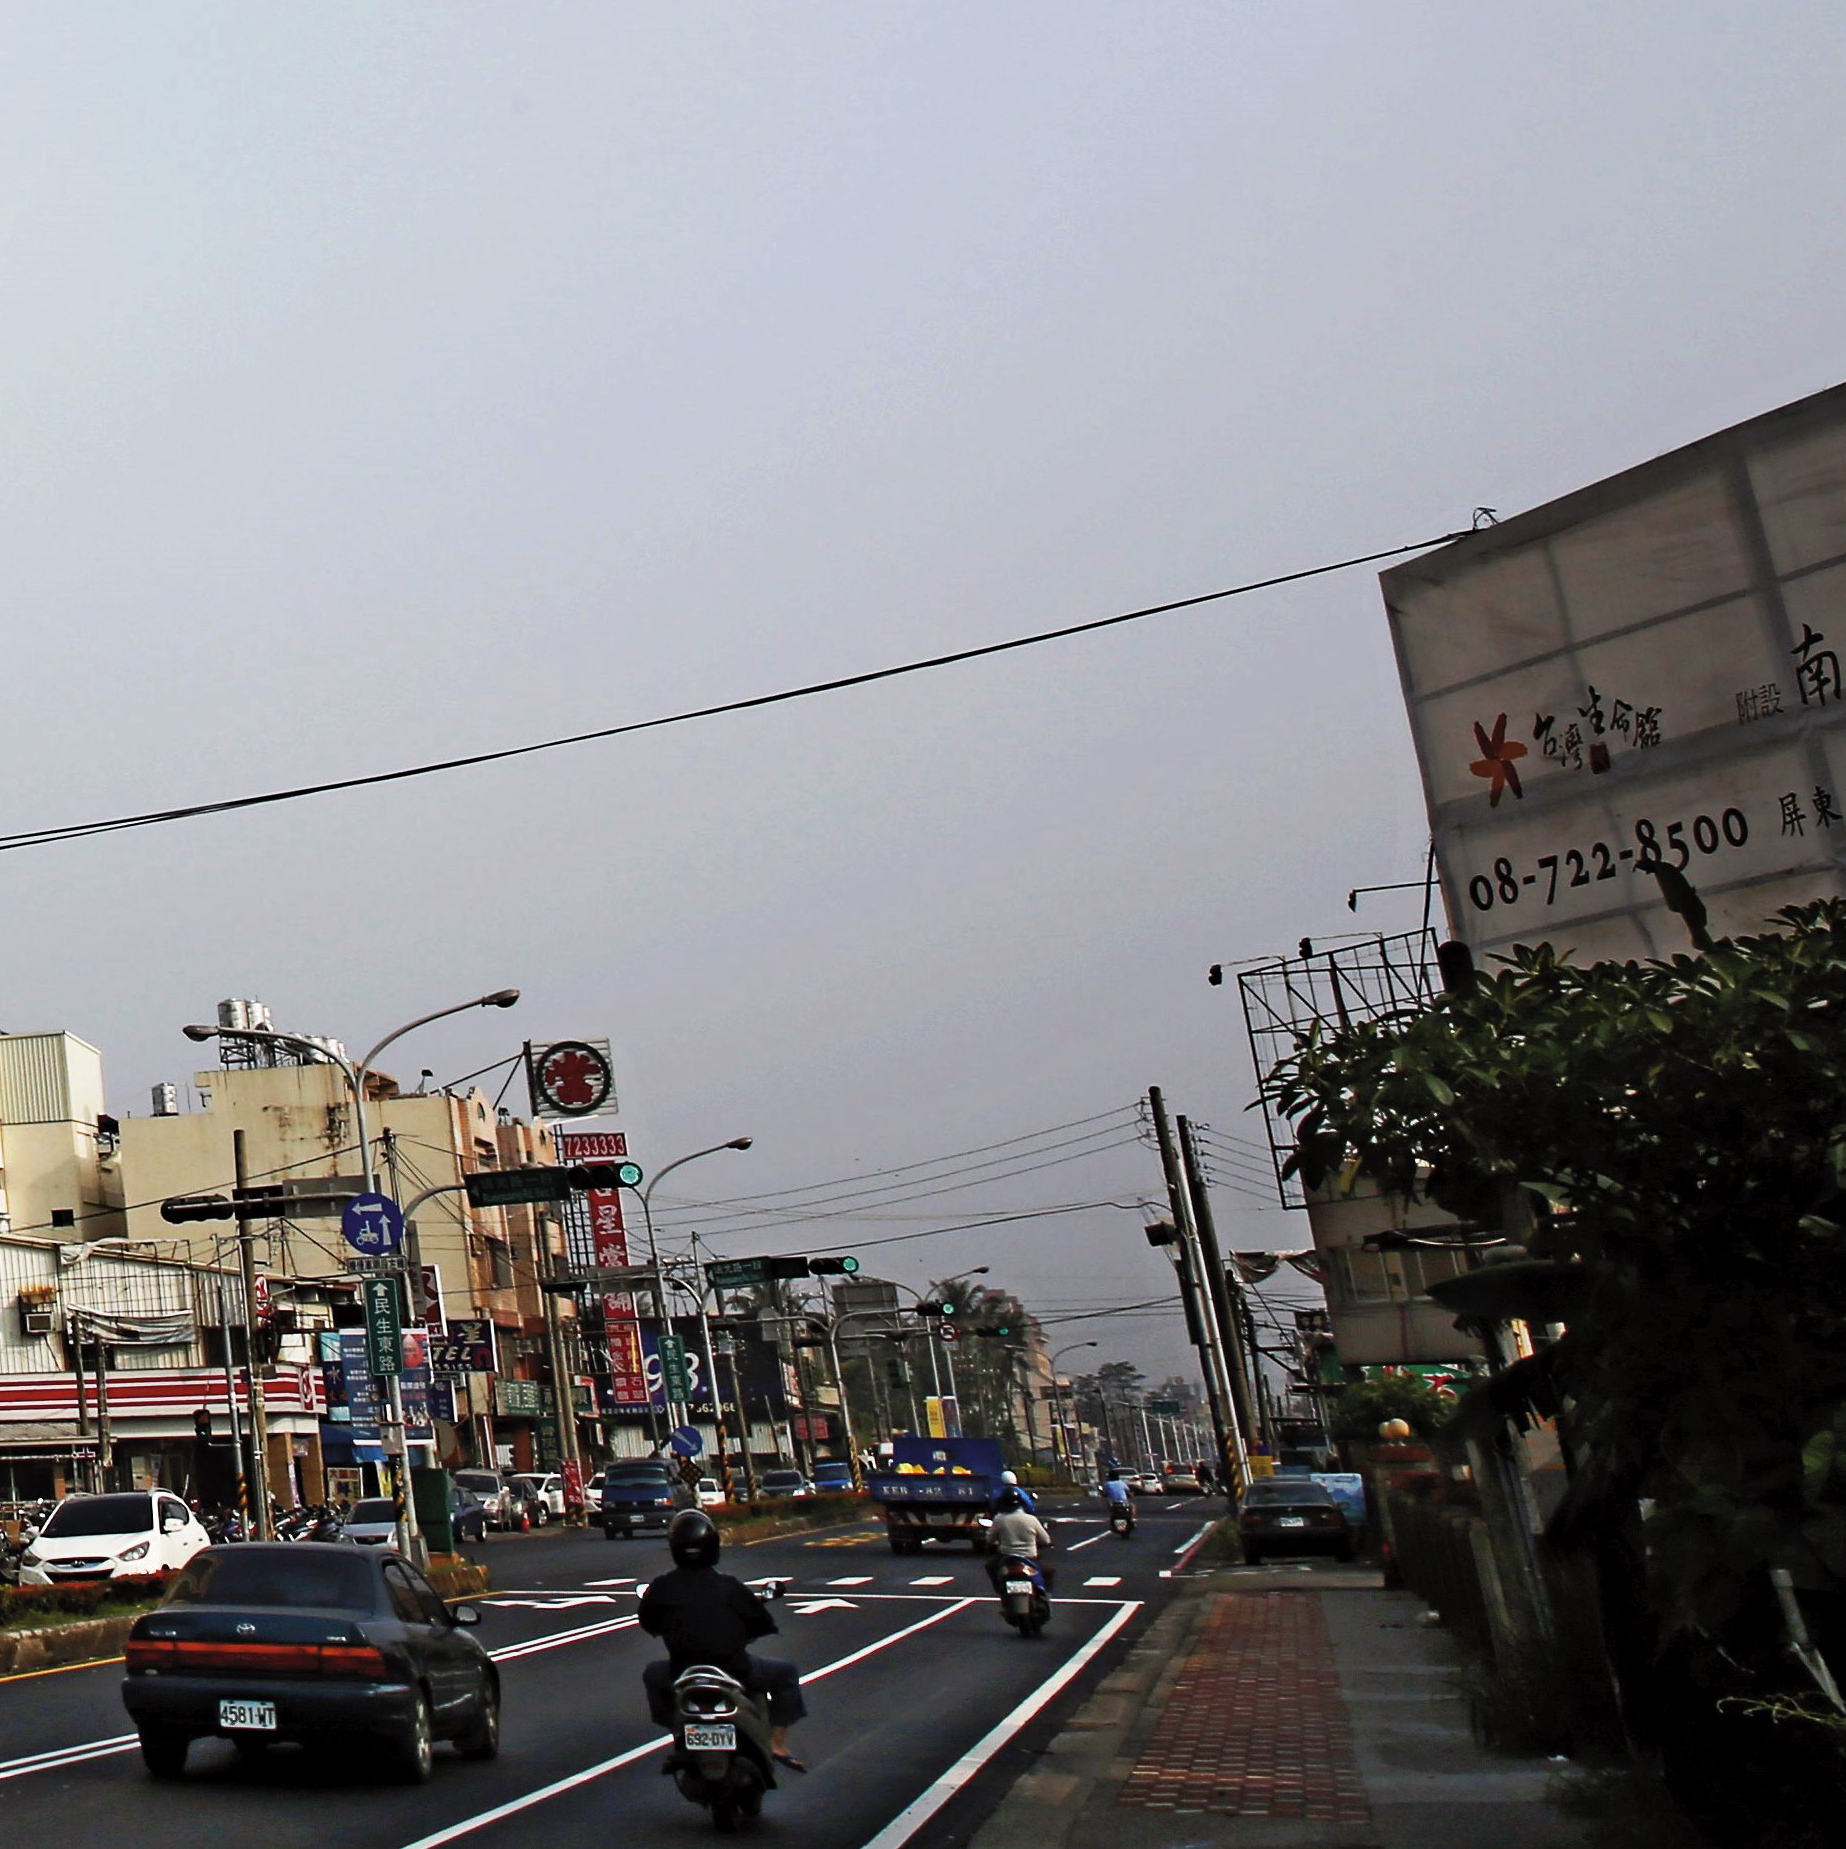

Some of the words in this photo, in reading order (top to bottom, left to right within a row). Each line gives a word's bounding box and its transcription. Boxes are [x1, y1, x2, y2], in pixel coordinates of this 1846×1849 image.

[1736, 683, 1786, 726] 附設
[1790, 623, 1842, 707] 南
[1469, 806, 1749, 912] 08-722-8500
[1778, 785, 1844, 838] 屏東
[565, 1135, 625, 1156] 7233333
[374, 1298, 396, 1371] 民生東路
[221, 1704, 276, 1728] 4581-WT
[686, 1732, 734, 1747] 692-DYV
